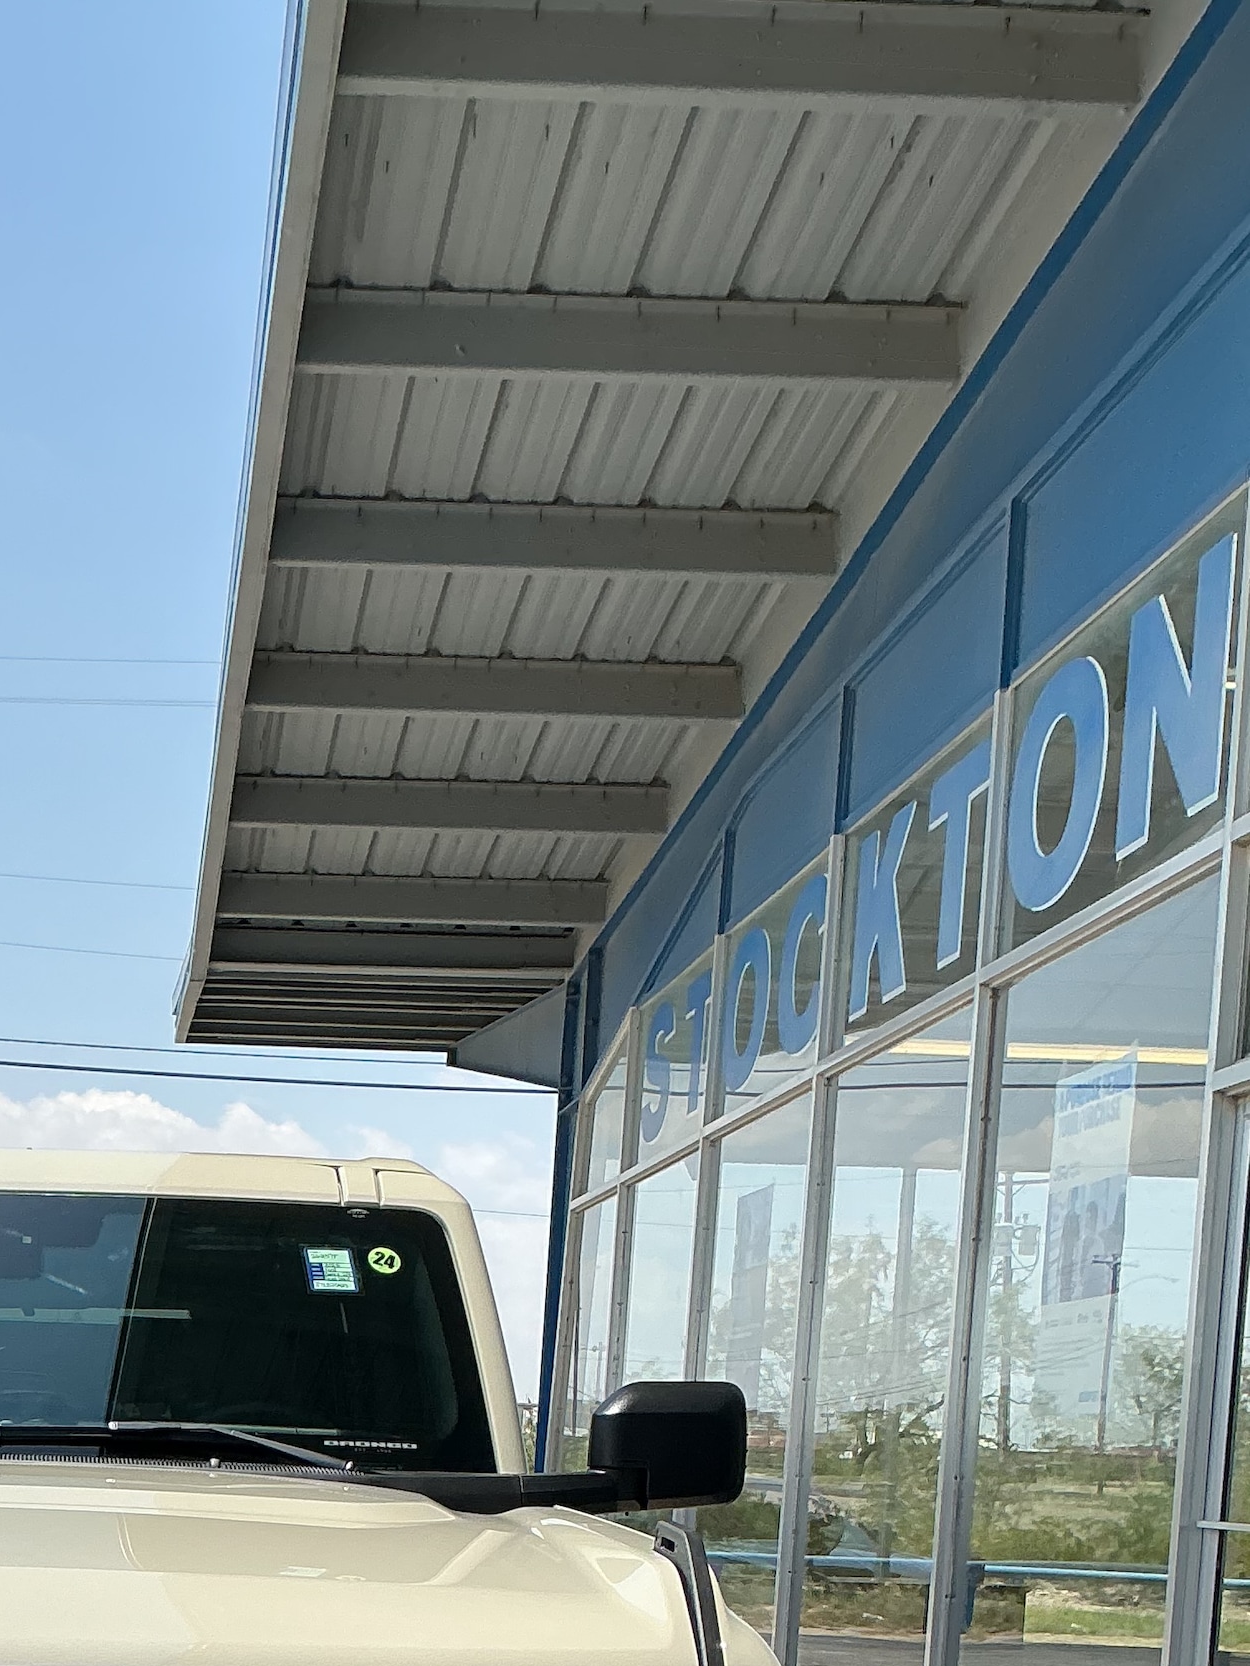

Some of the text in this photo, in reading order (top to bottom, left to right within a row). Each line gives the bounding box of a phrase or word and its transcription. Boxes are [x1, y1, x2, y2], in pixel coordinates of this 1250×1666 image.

[640, 532, 1238, 1144] STOCKTON
[372, 1251, 396, 1269] 24
[323, 1440, 418, 1449] BRONCO
